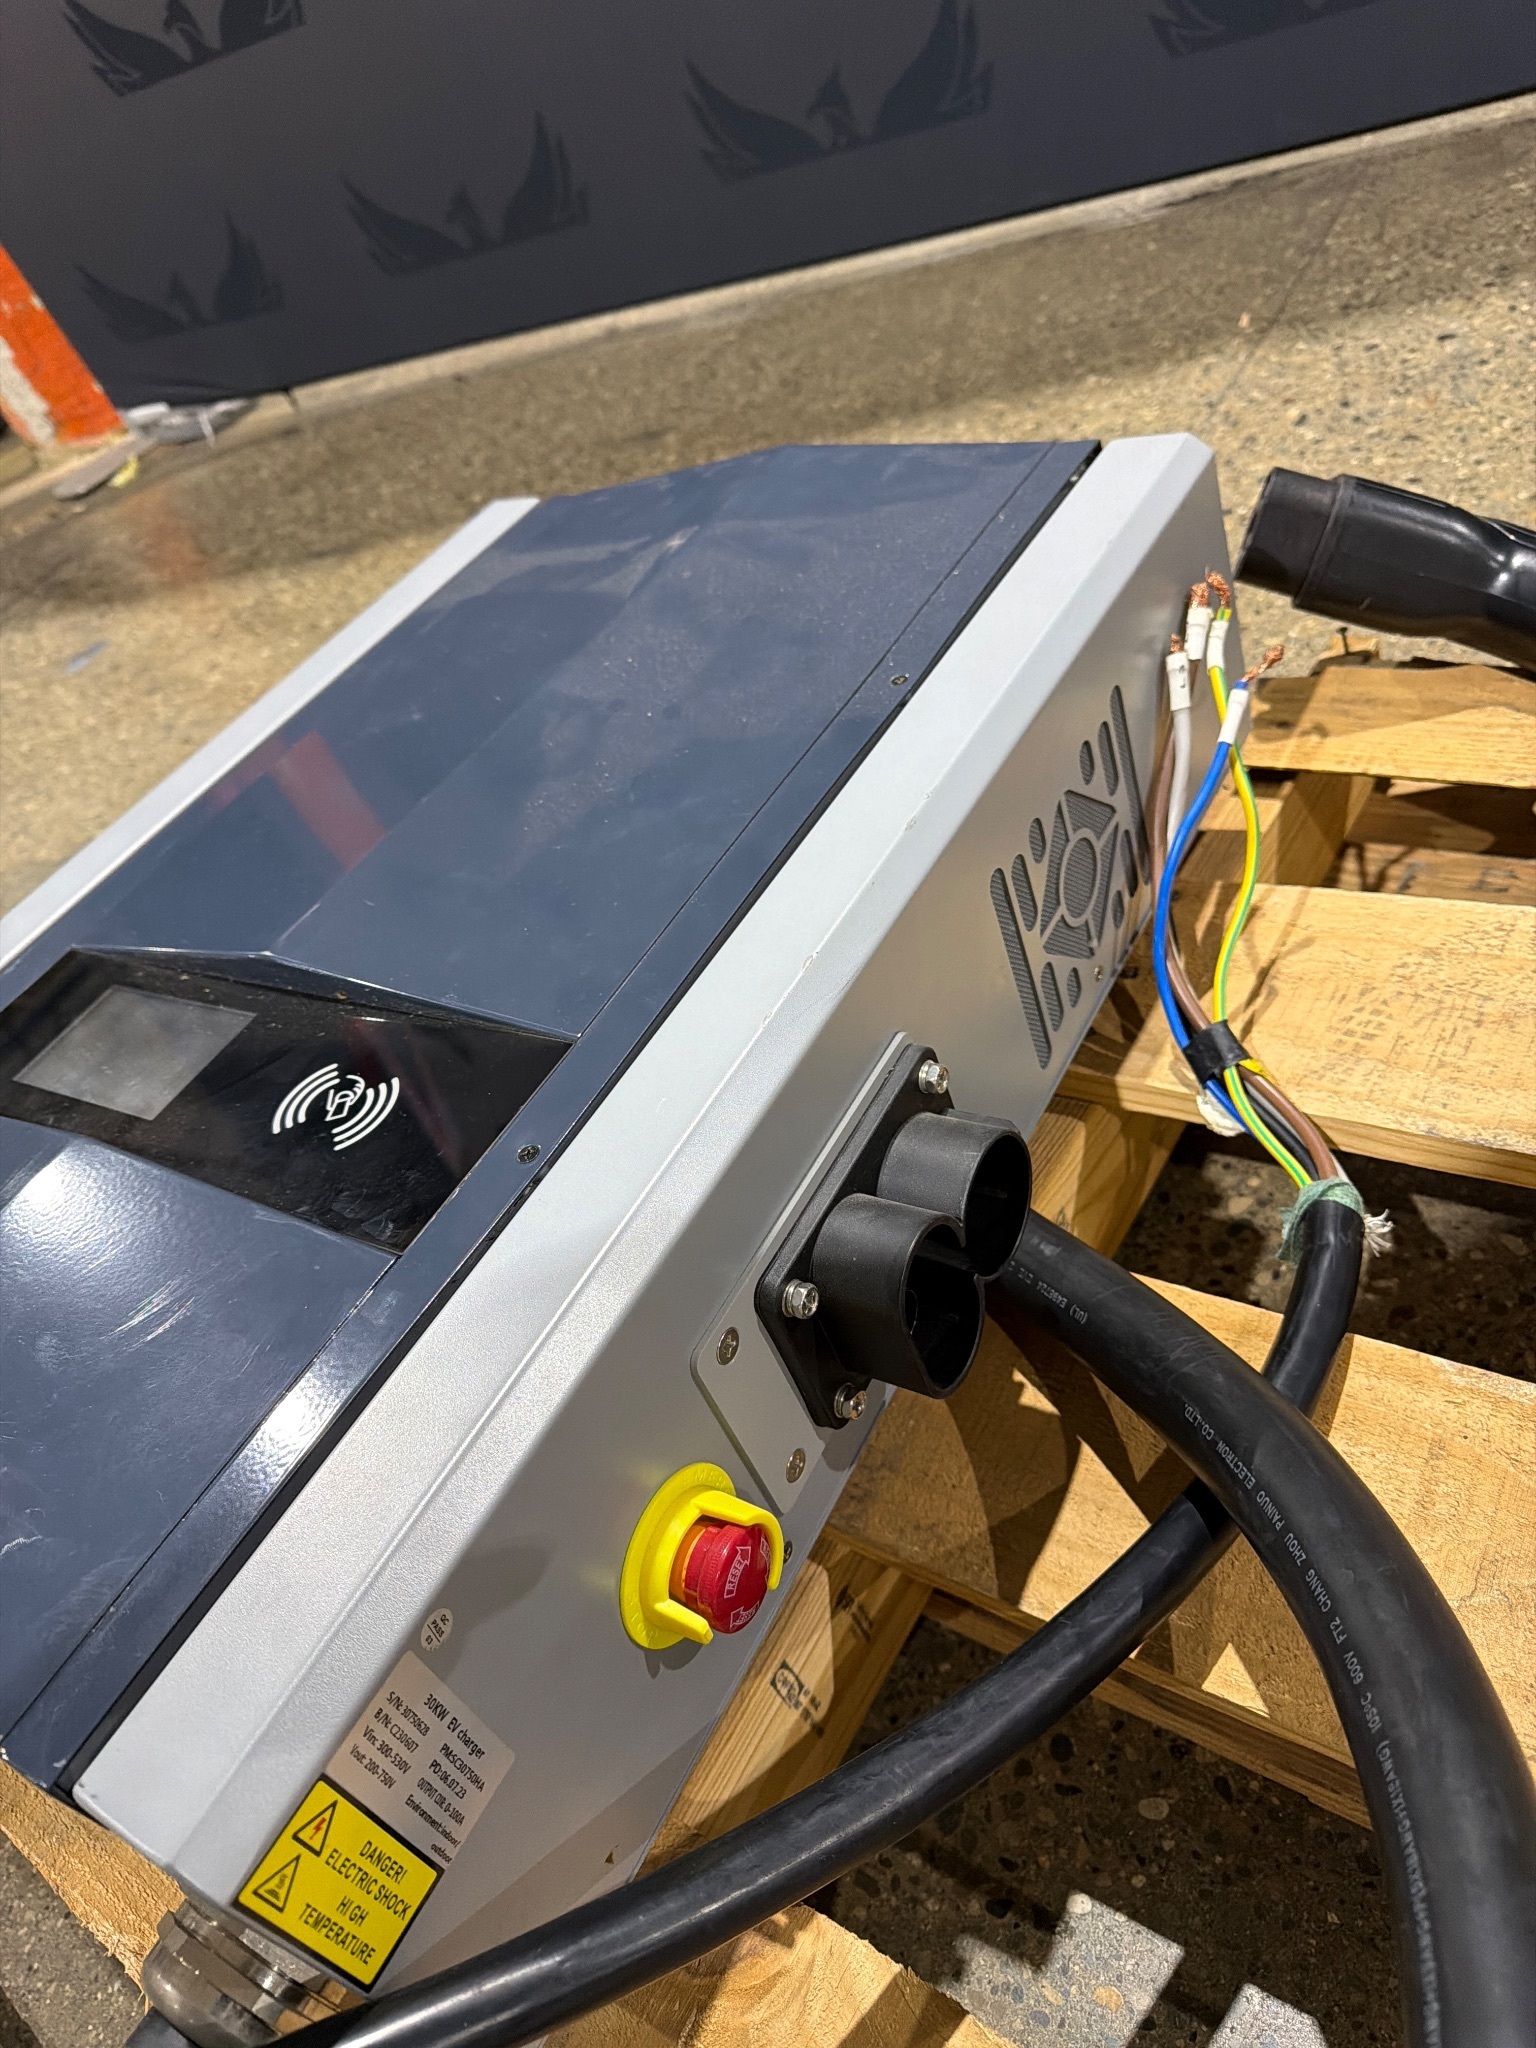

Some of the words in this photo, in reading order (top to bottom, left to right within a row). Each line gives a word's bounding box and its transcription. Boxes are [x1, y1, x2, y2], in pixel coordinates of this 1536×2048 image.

[1069, 1304, 1088, 1325] (UL)
[1215, 1439, 1257, 1490] ELECTRON
[1256, 1490, 1285, 1532] PAINUO
[1284, 1532, 1307, 1567] ZHOU
[727, 1555, 744, 1590] RESET
[1305, 1568, 1332, 1613] CHANG
[431, 1619, 445, 1637] PASS
[440, 1614, 450, 1625] QC
[1329, 1616, 1348, 1645] FT2
[1343, 1650, 1364, 1685] 600V
[390, 1724, 419, 1753] C230607
[423, 1693, 450, 1722] 30KW
[447, 1716, 461, 1733] EV
[457, 1729, 485, 1760] charger
[363, 1724, 379, 1746] Vin:
[376, 1740, 411, 1774] 300-530V
[364, 1758, 397, 1789] 200-750V
[417, 1777, 438, 1800] OUTPUT
[444, 1802, 465, 1827] 0-100A
[359, 1839, 407, 1885] DANGER!
[325, 1848, 378, 1896] ELECTRIC
[373, 1884, 412, 1922] SHOCK
[336, 1896, 369, 1928] HIGH
[299, 1903, 377, 1966] TEMPERATURE
